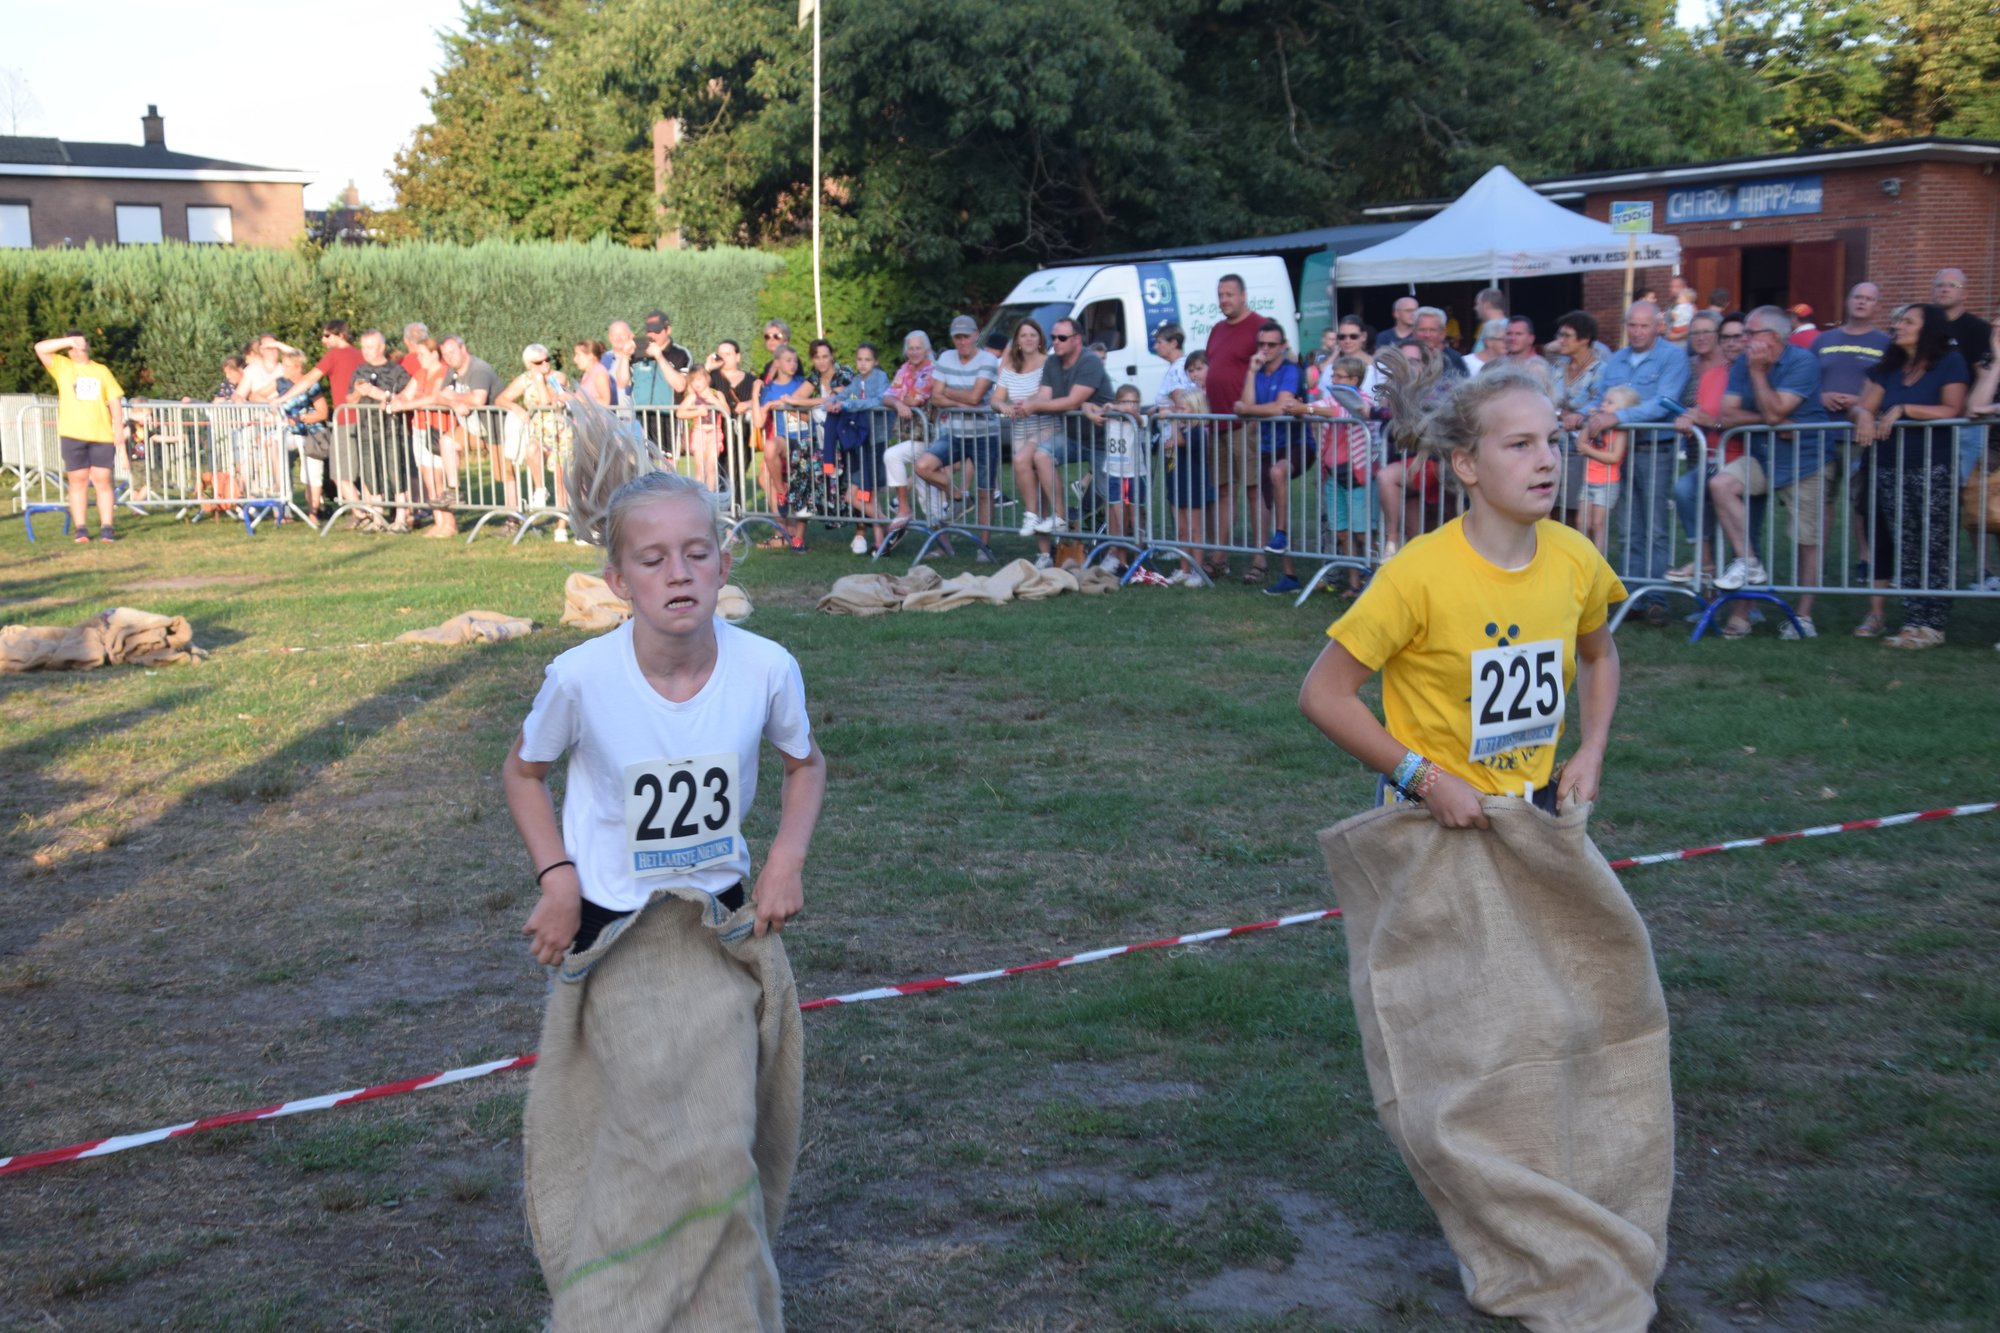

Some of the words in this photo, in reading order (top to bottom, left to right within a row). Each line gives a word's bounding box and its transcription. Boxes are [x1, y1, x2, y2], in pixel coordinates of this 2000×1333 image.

[1569, 245, 1662, 265] www.essn.be
[1144, 277, 1172, 305] 50
[1479, 650, 1559, 726] 225
[634, 766, 731, 841] 223
